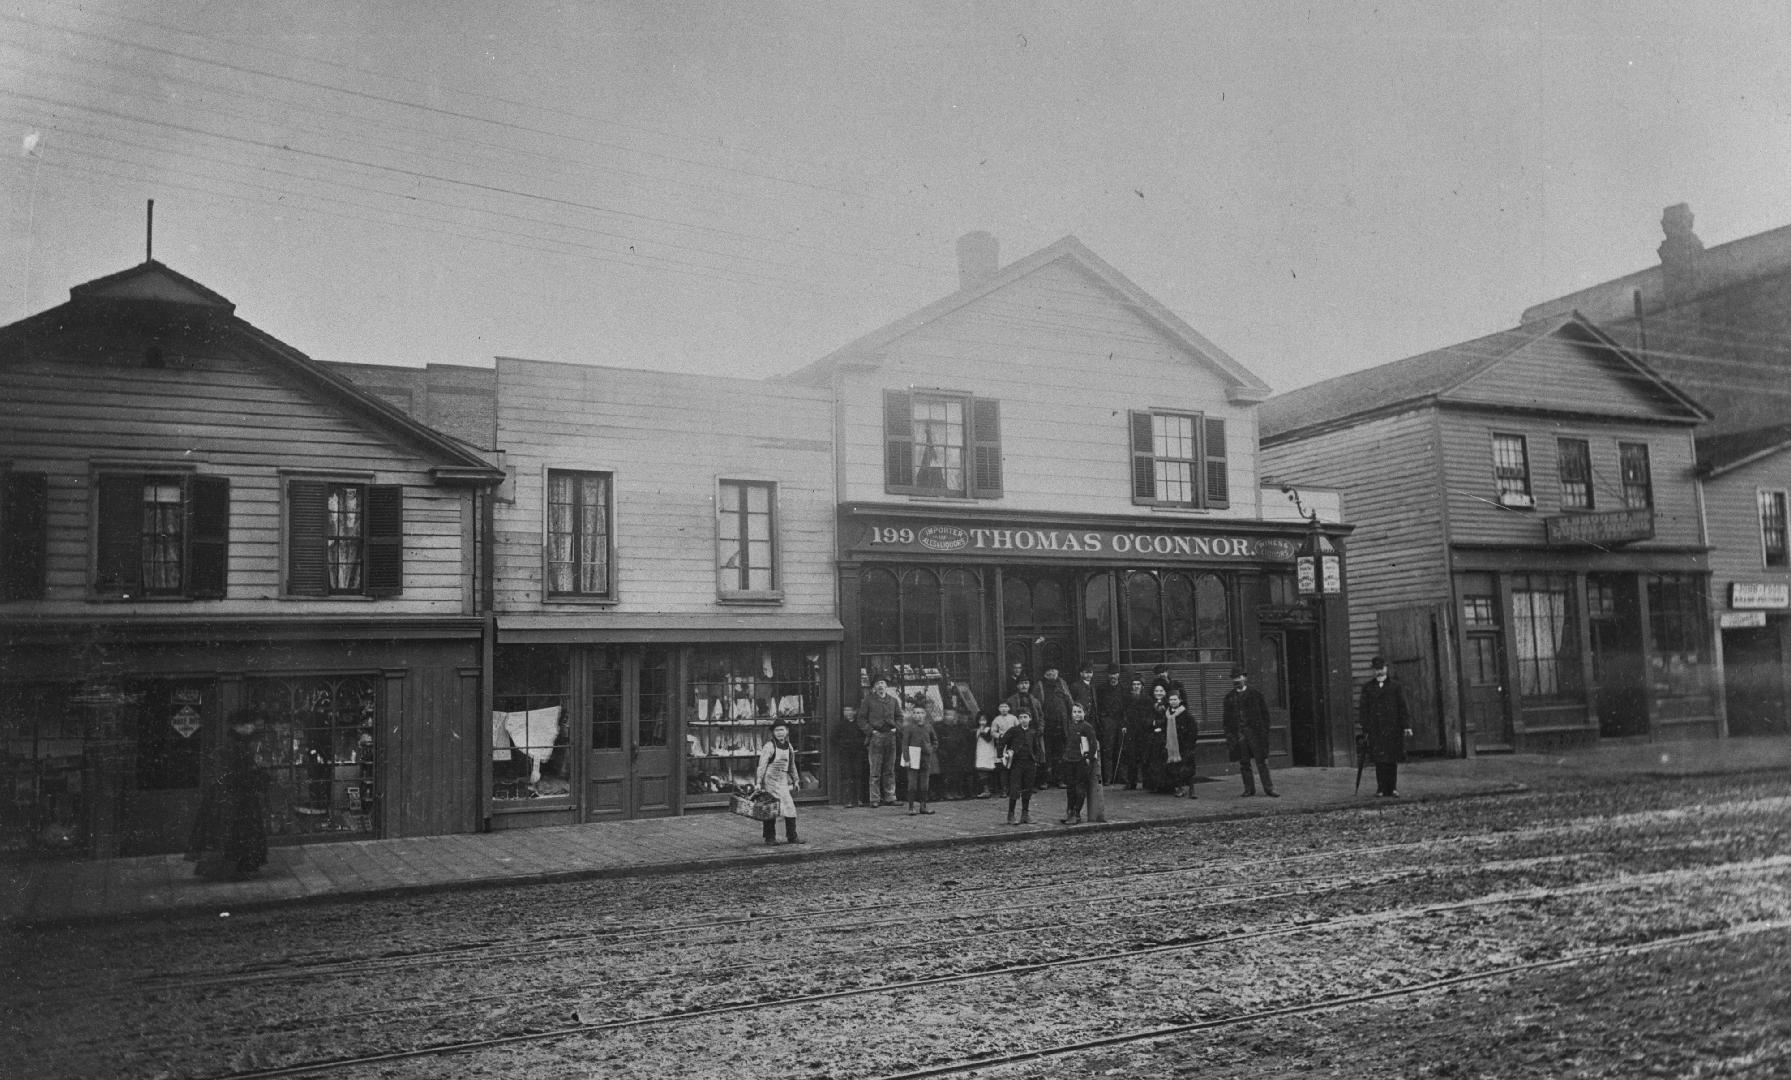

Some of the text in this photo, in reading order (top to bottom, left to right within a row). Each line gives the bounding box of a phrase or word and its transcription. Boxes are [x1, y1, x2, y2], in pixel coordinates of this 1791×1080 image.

[872, 526, 915, 544] 199
[925, 527, 964, 538] IMPORTER
[969, 528, 1102, 551] THOMAS
